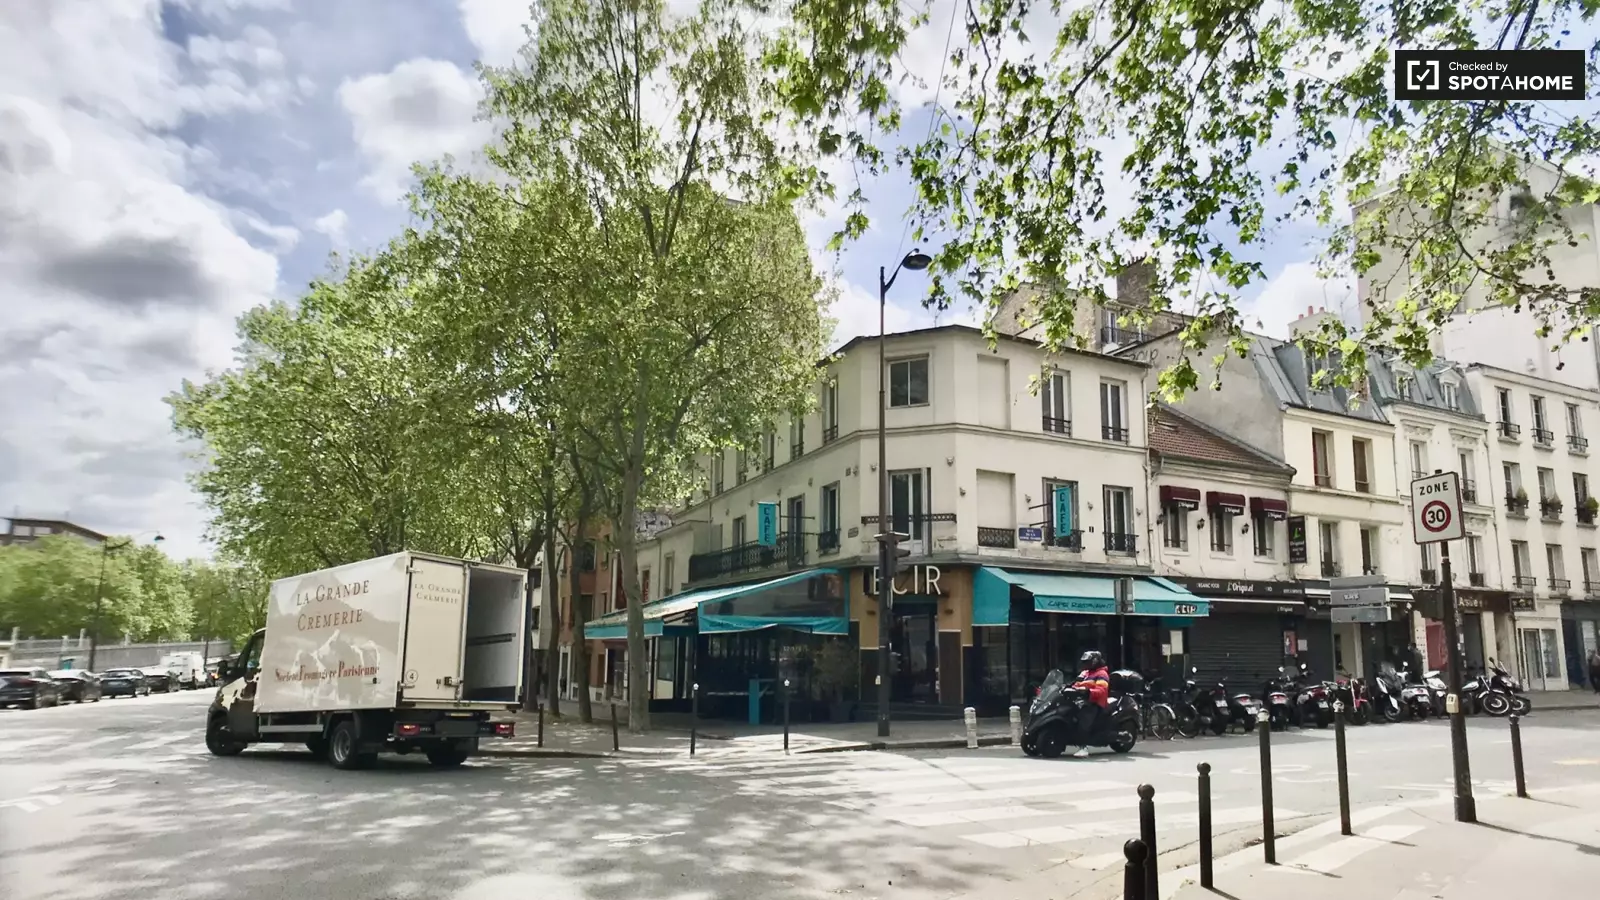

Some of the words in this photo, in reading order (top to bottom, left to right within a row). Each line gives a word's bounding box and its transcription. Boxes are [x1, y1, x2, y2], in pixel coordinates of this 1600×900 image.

[1419, 481, 1449, 496] ZONE
[1427, 508, 1446, 524] 30
[296, 592, 310, 606] LA
[315, 579, 370, 602] GRANDE
